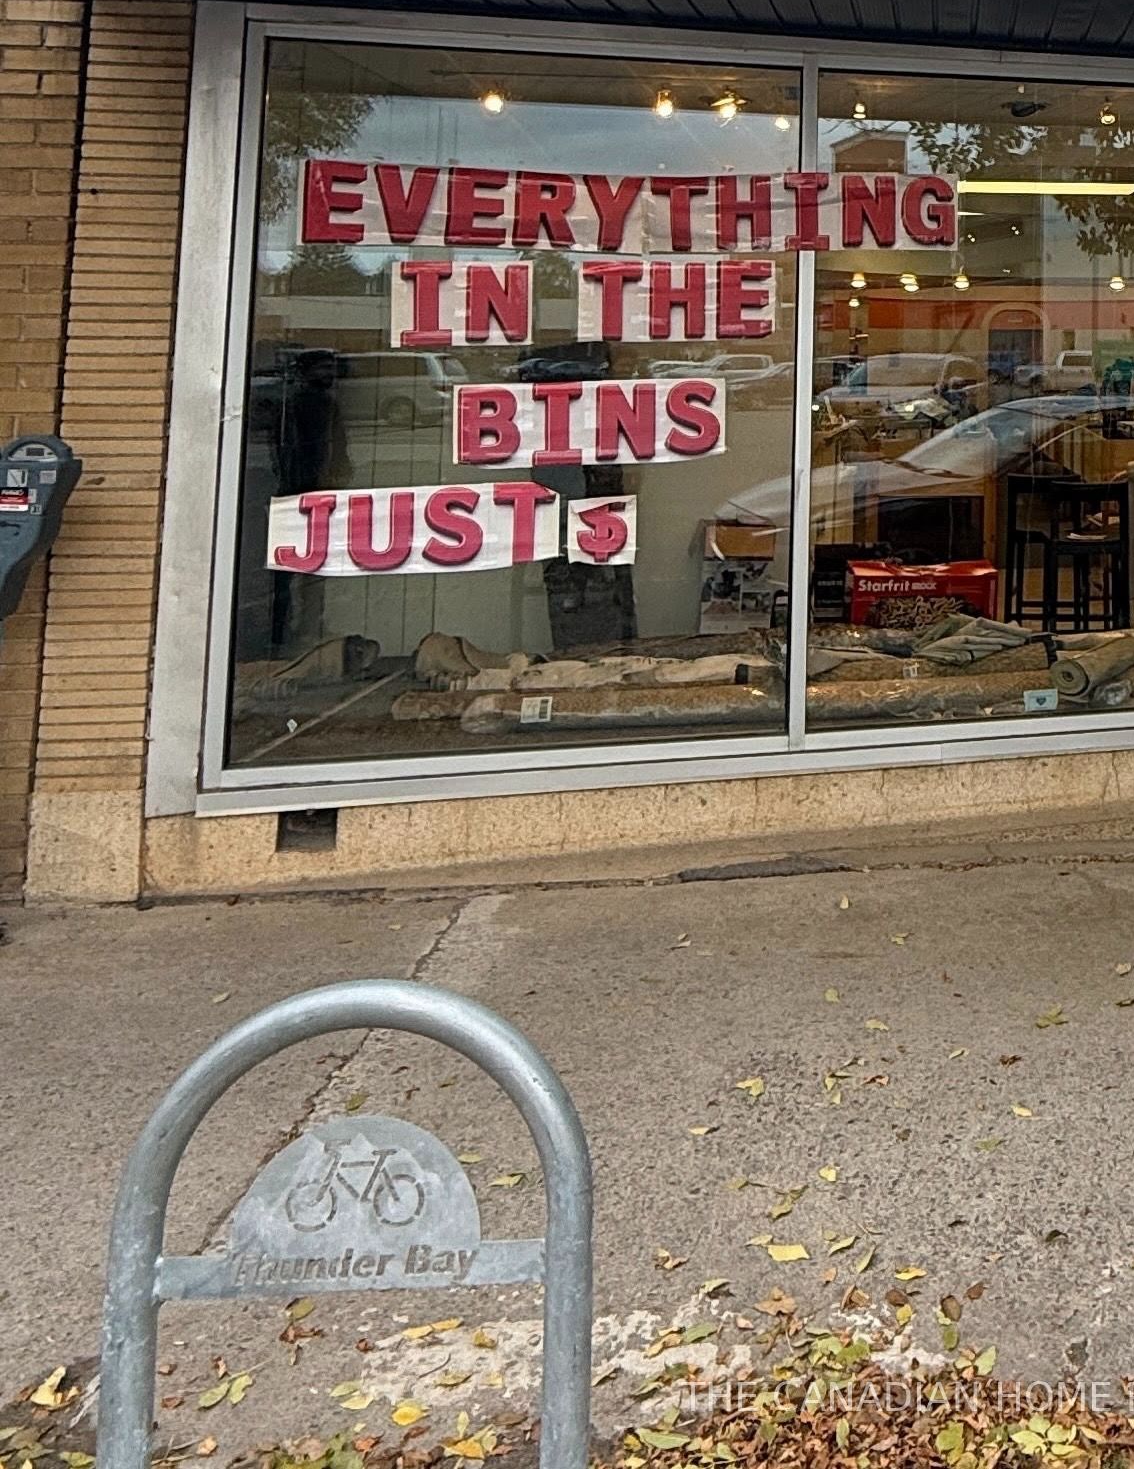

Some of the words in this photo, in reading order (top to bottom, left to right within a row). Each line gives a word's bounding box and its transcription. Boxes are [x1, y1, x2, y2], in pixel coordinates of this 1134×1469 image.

[302, 158, 956, 252] EVERYTHING
[400, 261, 530, 348] IN
[582, 260, 774, 342] THE
[457, 380, 721, 466] BINS
[274, 481, 556, 573] JUST
[858, 579, 910, 592] Starfrit
[233, 1248, 396, 1285] Thunder
[404, 1244, 482, 1281] Bay
